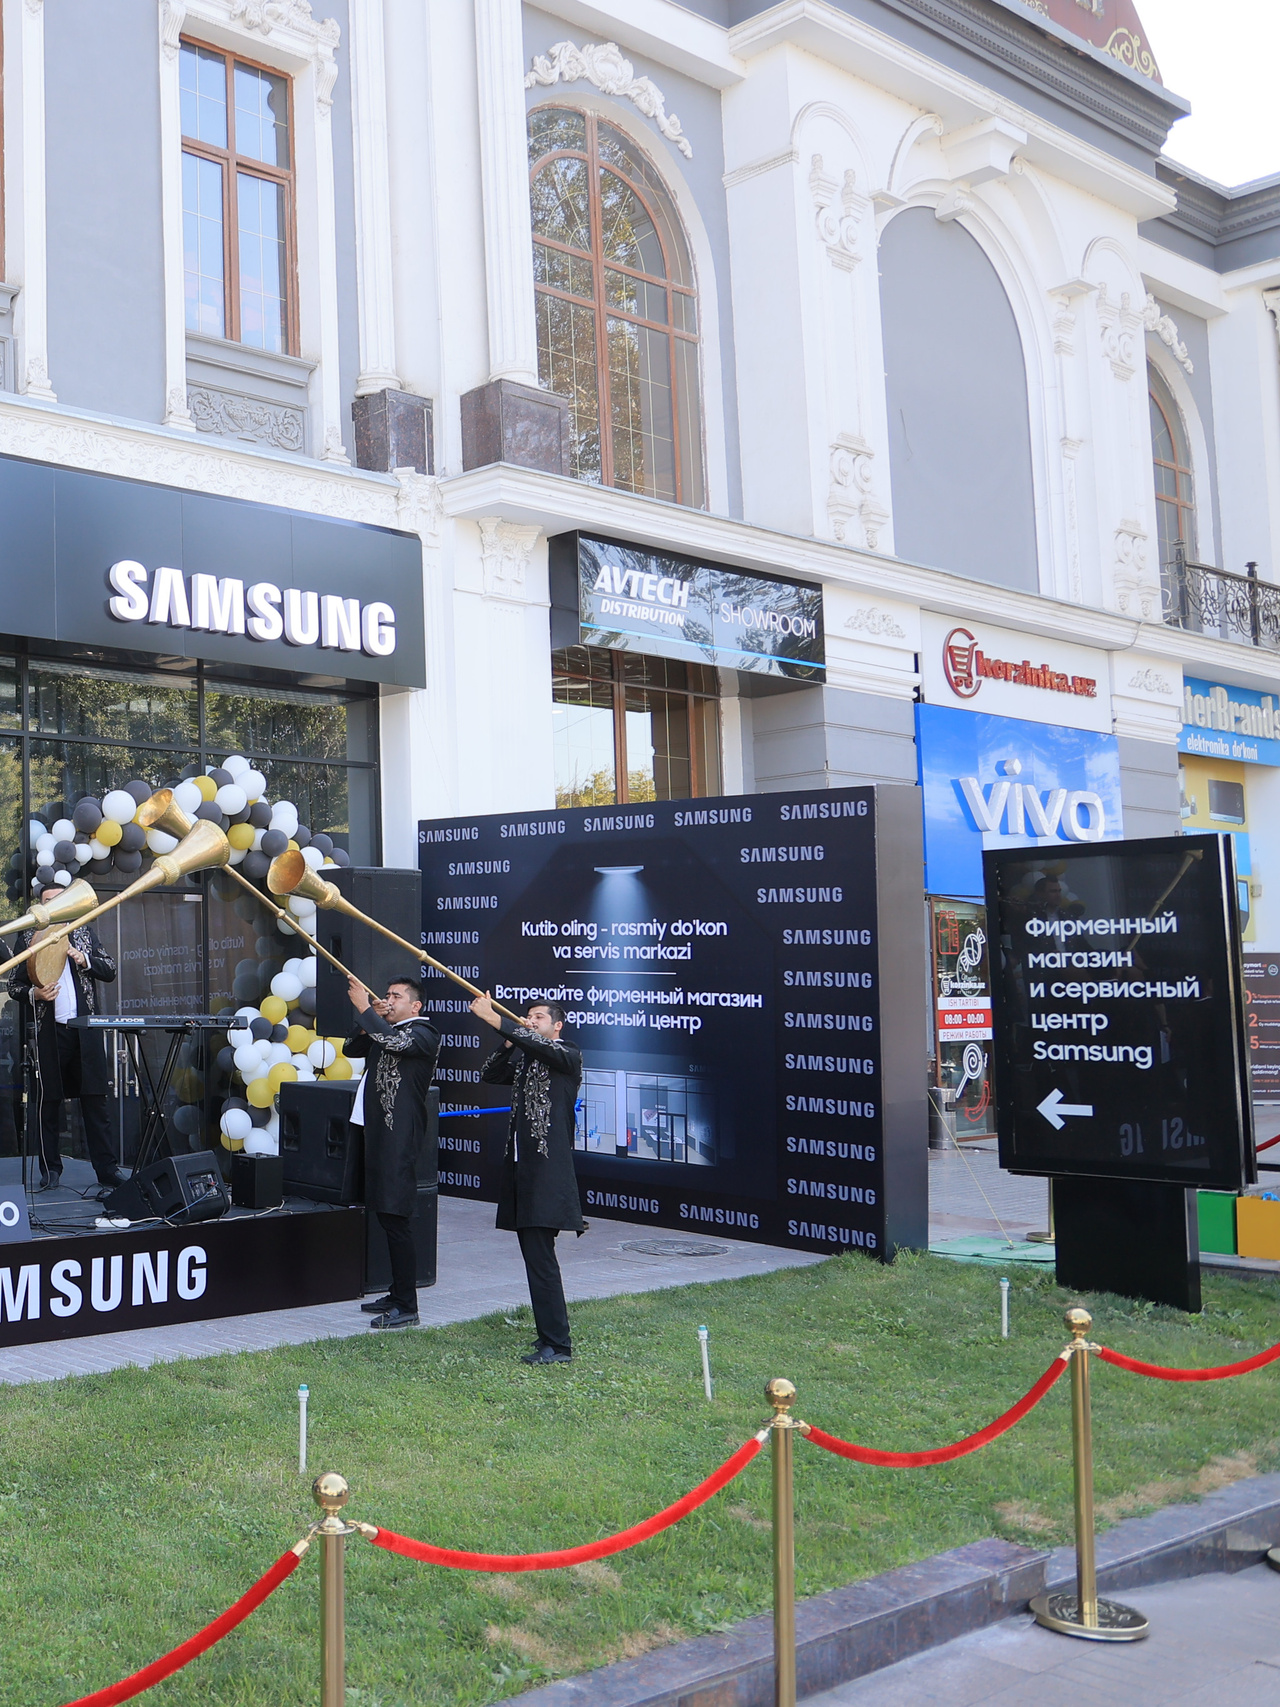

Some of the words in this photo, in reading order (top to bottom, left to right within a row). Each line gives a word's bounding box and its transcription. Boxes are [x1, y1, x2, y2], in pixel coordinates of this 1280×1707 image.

[593, 565, 689, 608] AVTECH
[109, 559, 396, 657] SAMSUNG
[600, 598, 685, 627] DISTRIBUTION
[720, 602, 816, 639] SHOWROOM
[975, 650, 1097, 697] korzinka.uz
[1186, 733, 1230, 756] elektronika
[957, 758, 1105, 842] vivo
[674, 807, 752, 827] SAMSUNG
[780, 801, 868, 821] SAMSUNG
[500, 820, 566, 838] SAMSUNG
[583, 814, 655, 832] SAMSUNG
[418, 826, 479, 844] SAMSUNG
[740, 845, 825, 864] SAMSUNG
[448, 860, 511, 876] SAMSUNG
[437, 896, 498, 910] SAMSUNG
[757, 886, 843, 904] SAMSUNG
[522, 920, 558, 937] Kutib
[560, 919, 598, 941] oling
[612, 918, 667, 940] rasmiy
[670, 919, 728, 936] do'kon
[1025, 911, 1178, 942] Фирменный
[421, 931, 480, 944] SAMSUNG
[782, 929, 871, 946] SAMSUNG
[552, 946, 571, 959] va
[574, 942, 620, 959] servis
[624, 942, 692, 960] markazi
[1028, 951, 1133, 968] магазин
[784, 970, 872, 988] SAMSUNG
[495, 984, 584, 1004] Встречайте
[587, 985, 684, 1006] фирменный
[688, 990, 762, 1008] магазин
[1030, 982, 1045, 998] и
[1050, 976, 1200, 1004] сервисный
[424, 1000, 472, 1013] AMSUN
[650, 1013, 702, 1034] центр
[784, 1012, 873, 1032] SAMSUNG
[1032, 1013, 1108, 1036] центр
[1248, 1012, 1258, 1028] 2
[440, 1034, 480, 1048] MSUNG
[943, 1032, 964, 1040] РЕЖИМ
[965, 1030, 986, 1038] РАБОТЫ
[1250, 1036, 1260, 1050] 5
[785, 1053, 874, 1075] SAMSUNG
[1033, 1040, 1153, 1070] Samsung
[434, 1068, 480, 1084] MSUNG
[786, 1095, 875, 1118] SAMSUNG
[438, 1136, 481, 1154] MSUNG
[786, 1136, 876, 1162] SAMSUNG
[438, 1170, 481, 1188] MSUNG
[586, 1190, 660, 1214] SAMSUNG
[787, 1178, 876, 1206] SAMSUNG
[680, 1204, 760, 1229] SAMSUNG
[788, 1220, 877, 1248] SAMSUNG
